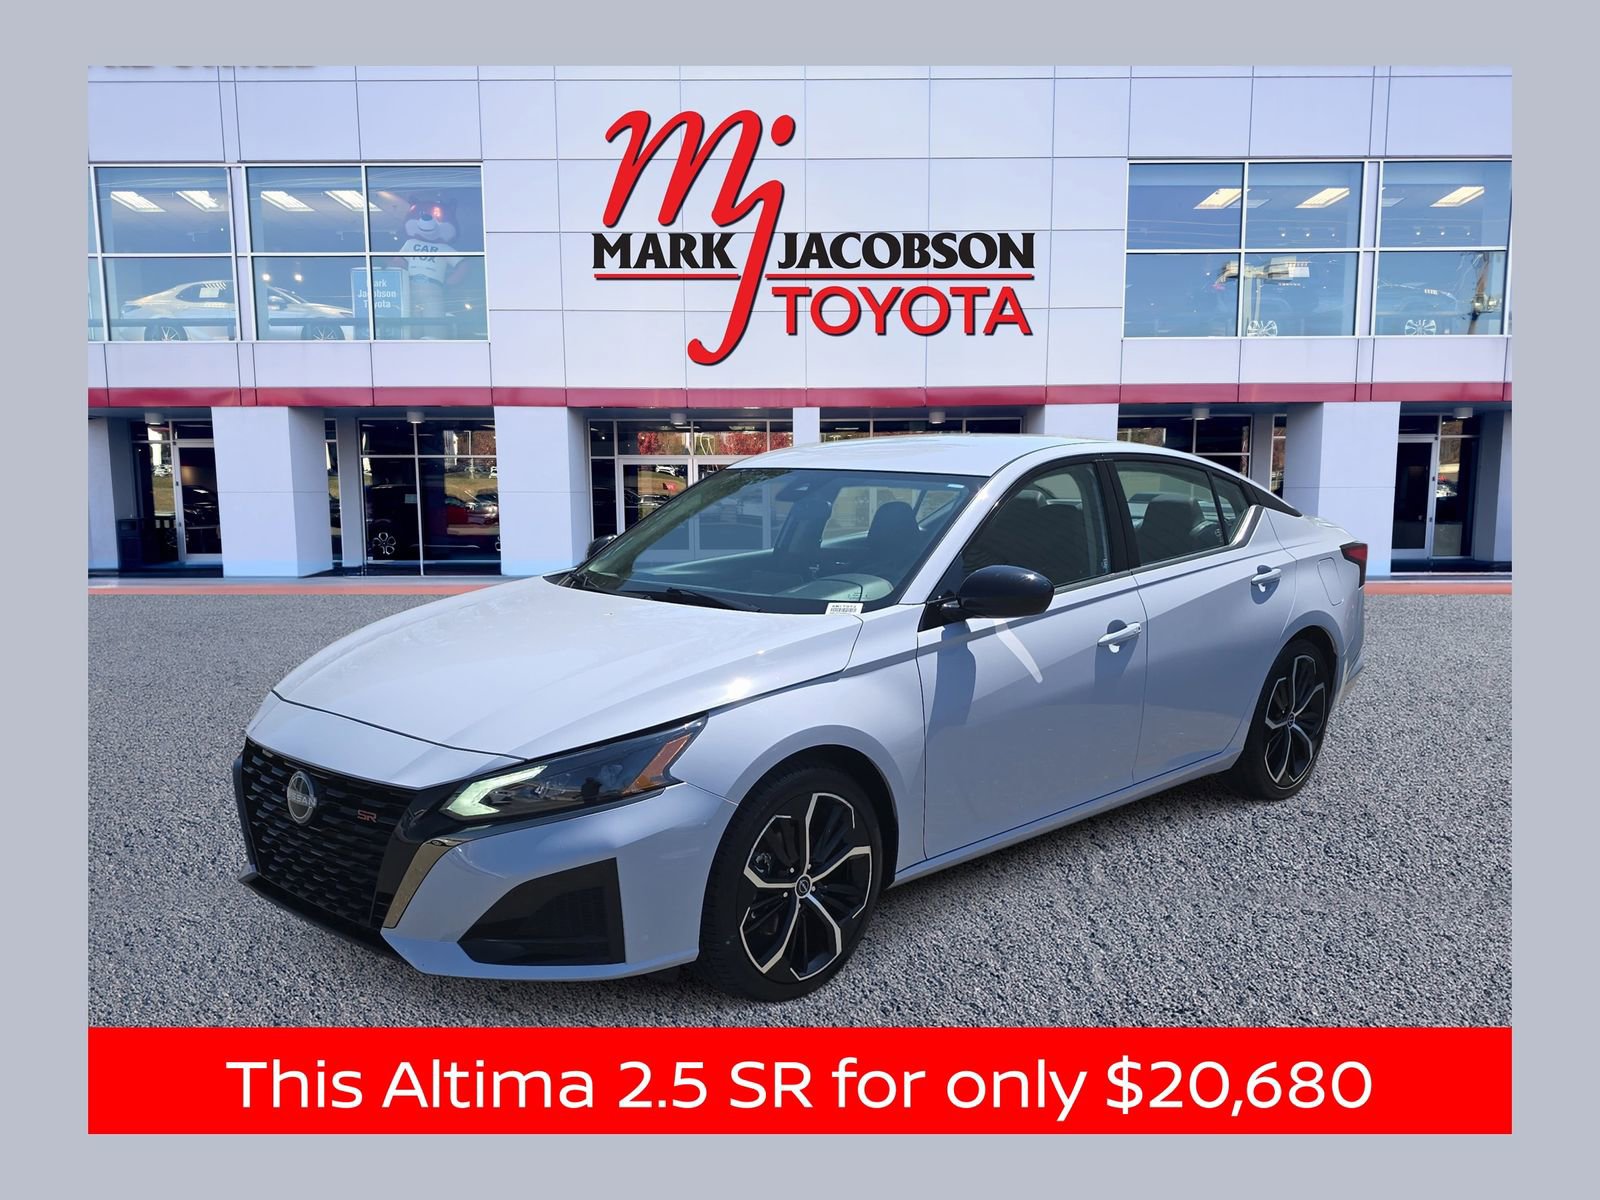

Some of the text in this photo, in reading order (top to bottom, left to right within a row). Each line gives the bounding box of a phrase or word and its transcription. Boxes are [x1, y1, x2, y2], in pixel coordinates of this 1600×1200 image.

[591, 232, 1035, 270] MARK JACOBSON
[771, 286, 1033, 336] TOYOTA
[356, 809, 377, 823] SR
